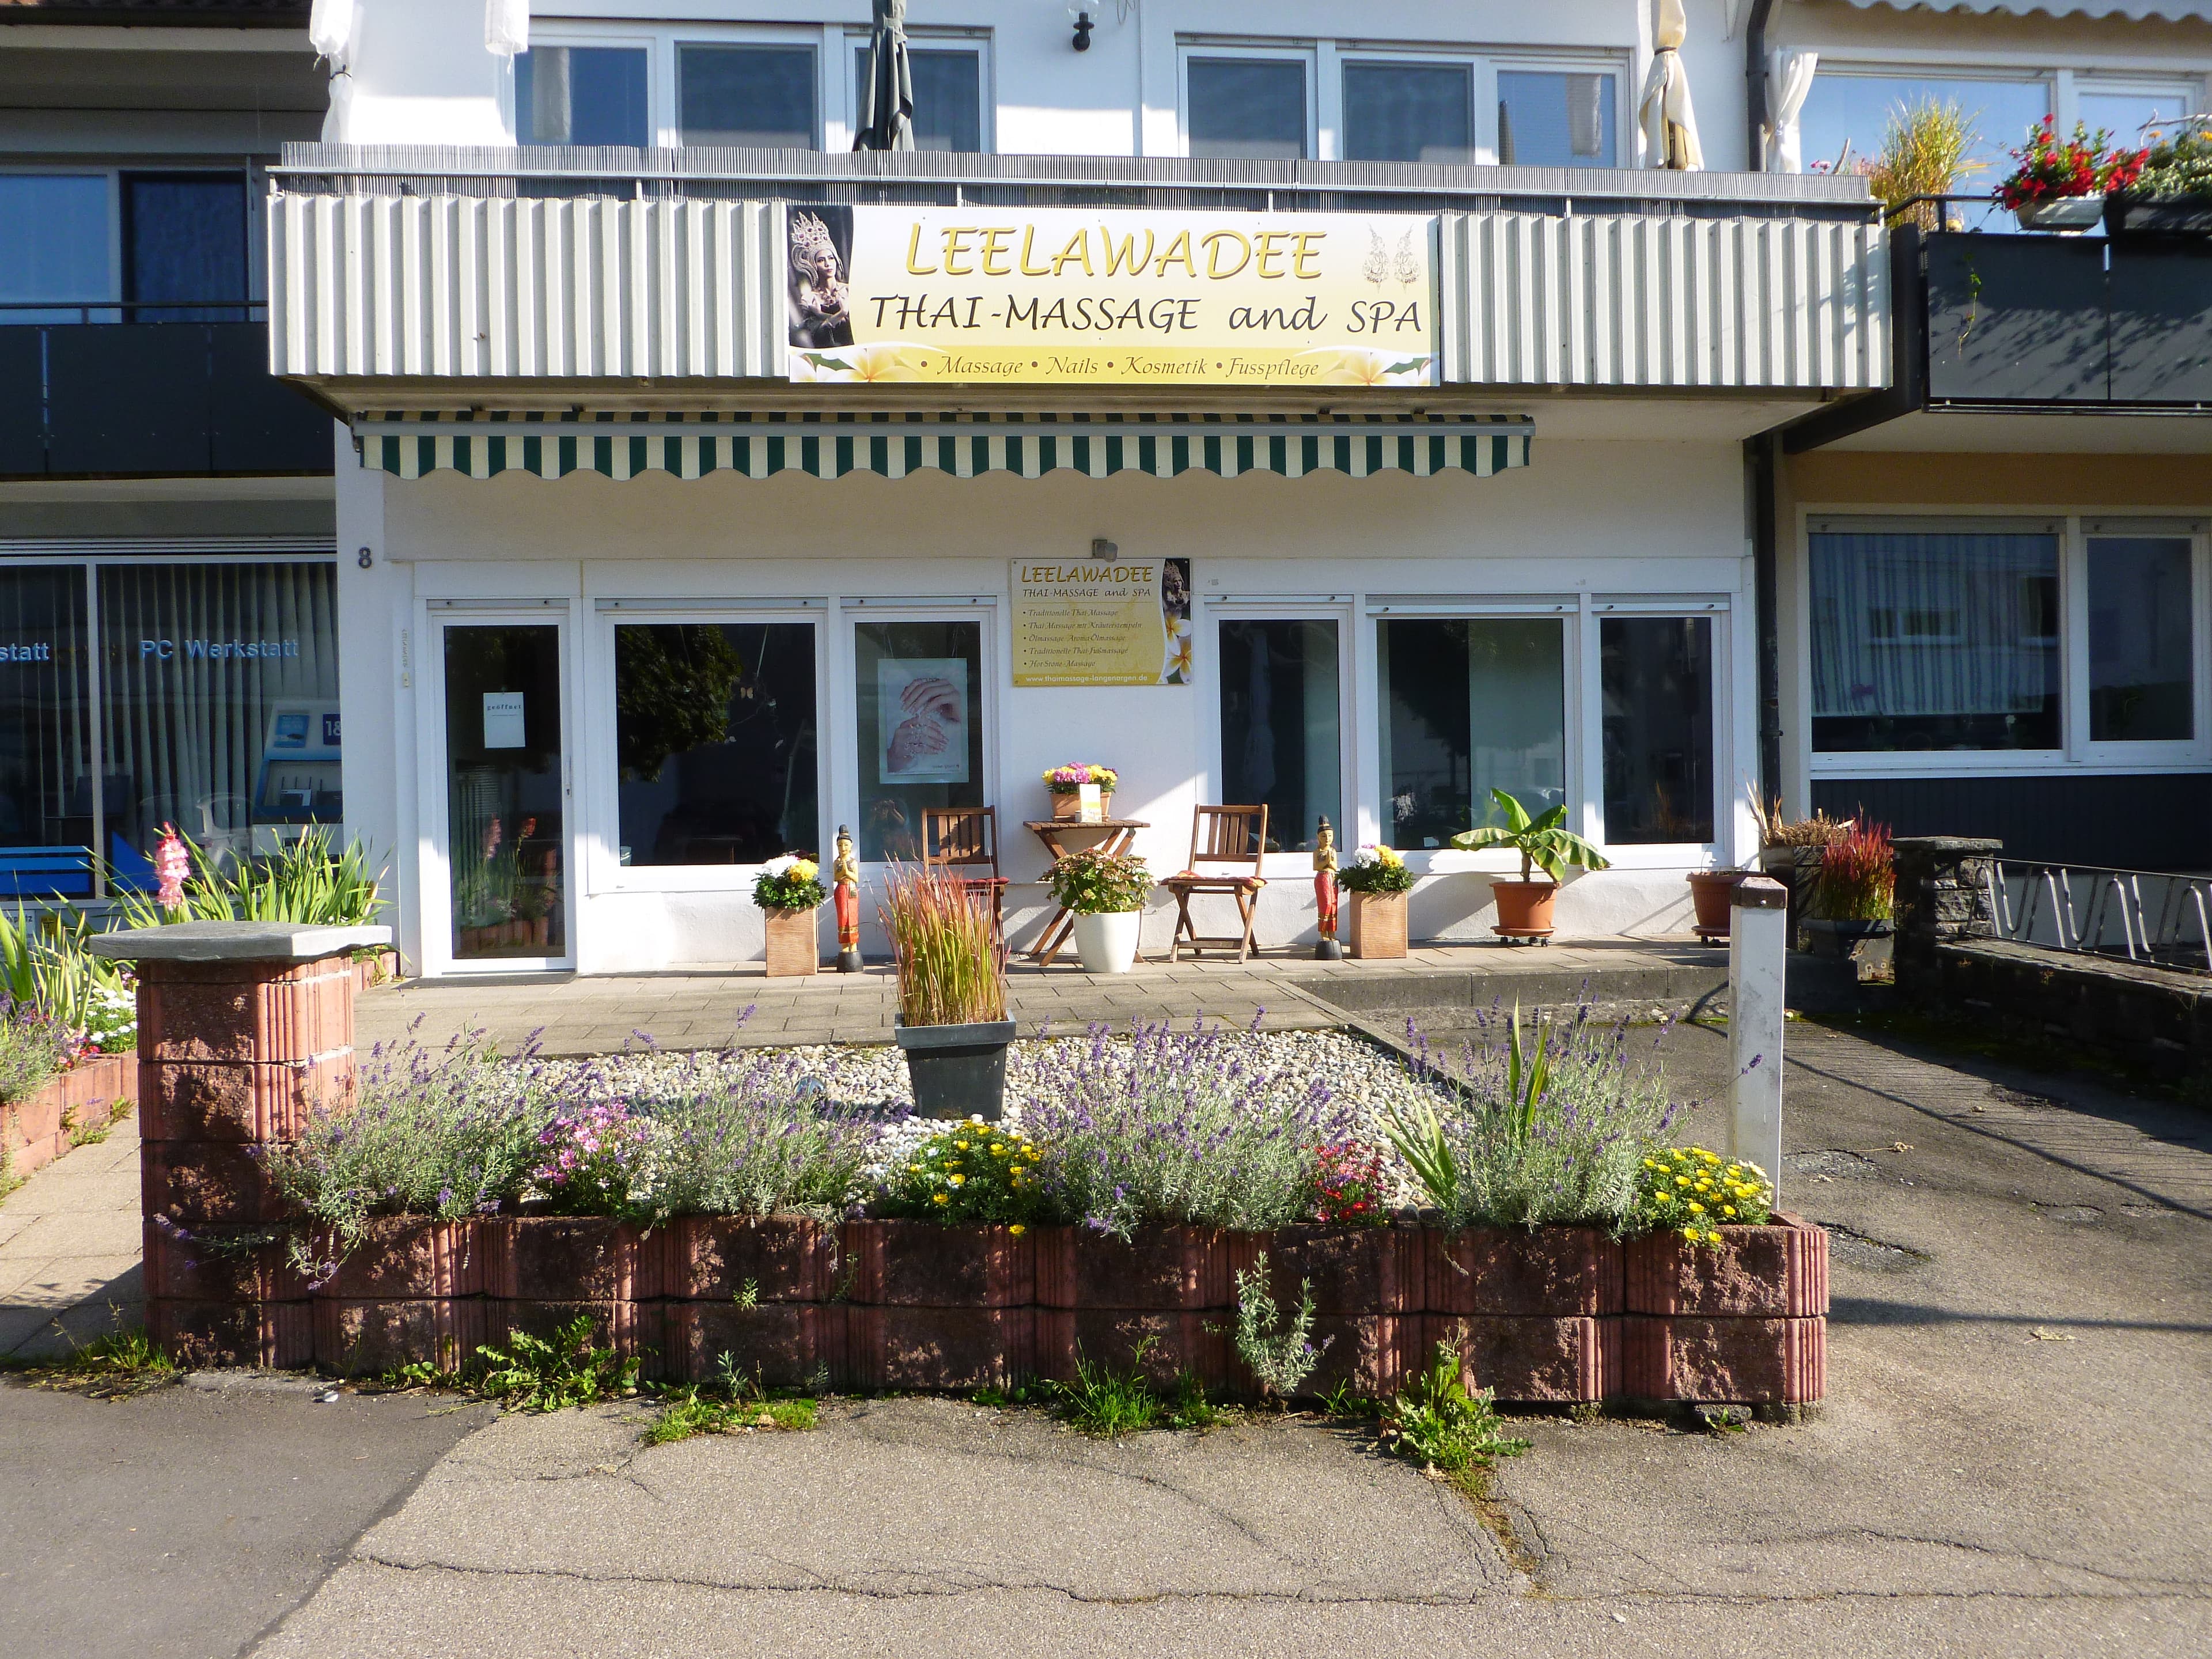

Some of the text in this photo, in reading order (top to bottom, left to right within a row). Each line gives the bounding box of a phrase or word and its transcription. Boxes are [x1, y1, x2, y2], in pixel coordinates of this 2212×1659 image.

[906, 222, 1327, 280] LEELAWADEE
[870, 293, 1422, 333] THAI-MASSAGE and SPA
[937, 355, 1319, 379] Massage Nails Kosmetik Fusspflege
[358, 547, 372, 569] 8
[1021, 565, 1153, 583] LEELAWADEE
[1022, 588, 1151, 597] THAI-MASSAGE and SPA
[0, 642, 50, 662] statt
[140, 639, 298, 659] PC Werkstatt
